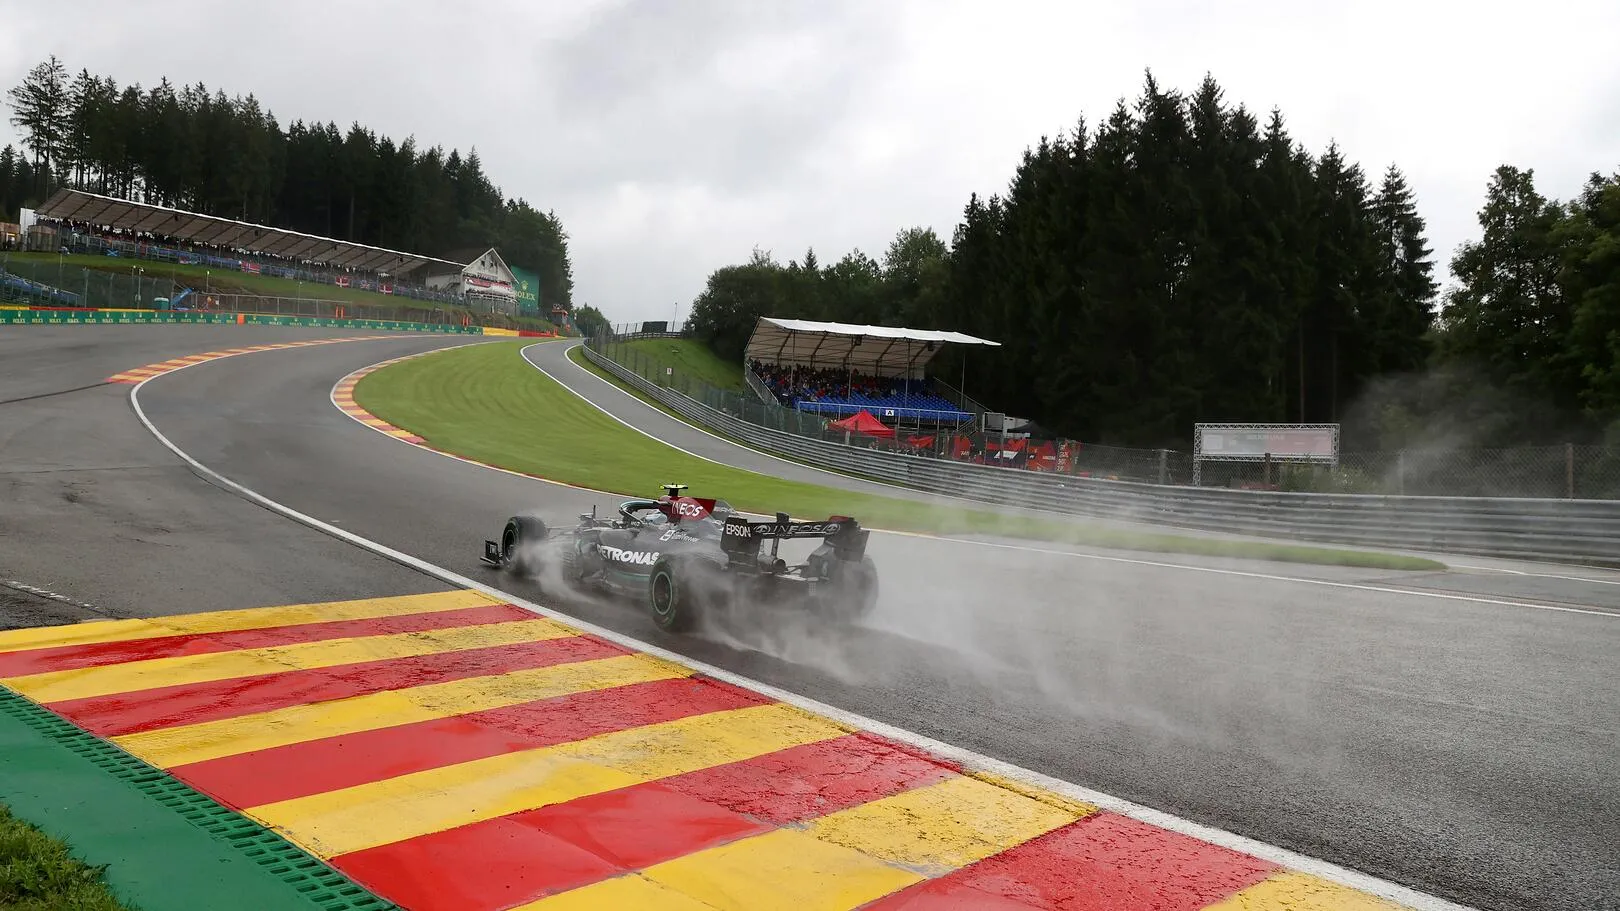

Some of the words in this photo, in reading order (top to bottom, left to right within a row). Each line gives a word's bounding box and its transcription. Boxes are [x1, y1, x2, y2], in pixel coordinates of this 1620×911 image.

[671, 502, 704, 517] INEOS
[726, 524, 752, 538] EPSON
[773, 525, 822, 535] INEOS
